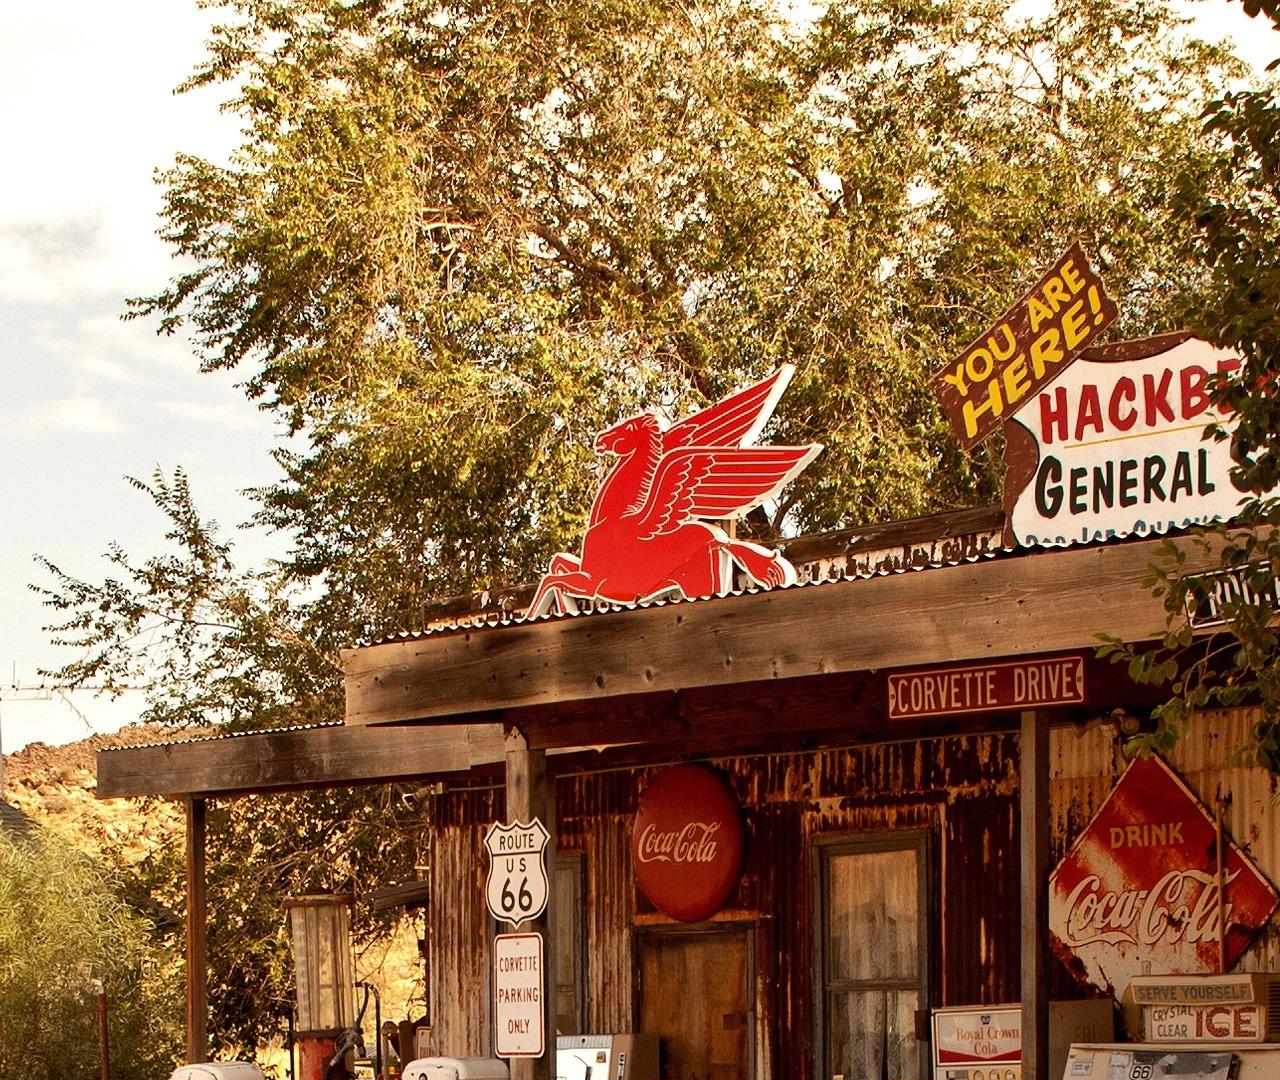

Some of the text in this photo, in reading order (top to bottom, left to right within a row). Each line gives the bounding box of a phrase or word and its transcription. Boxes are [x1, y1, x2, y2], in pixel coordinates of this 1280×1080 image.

[944, 260, 1086, 396] YOU ARE
[963, 285, 1104, 438] HERE!
[1039, 358, 1242, 444] HACKBE
[1035, 448, 1216, 519] GENERAL
[898, 663, 1073, 712] CORVETTE DRIVE
[500, 834, 534, 849] ROUTE
[638, 822, 721, 862] Coca-Cola
[1110, 822, 1184, 848] DRINK
[506, 858, 526, 873] US
[501, 877, 532, 912] 66
[1066, 868, 1242, 947] Coca-Cola
[500, 956, 537, 972] CORVETTE
[499, 987, 538, 1003] PARKING
[1138, 985, 1247, 1000] SERVE YOURSELF
[1153, 1005, 1195, 1022] CRYSTAL
[1195, 1006, 1256, 1038] ICE
[508, 1019, 529, 1034] ONLY
[956, 1026, 1019, 1044] Royal Crown
[1157, 1024, 1188, 1038] CLEAR
[974, 1042, 998, 1055] Cola
[1132, 1066, 1151, 1079] 66
